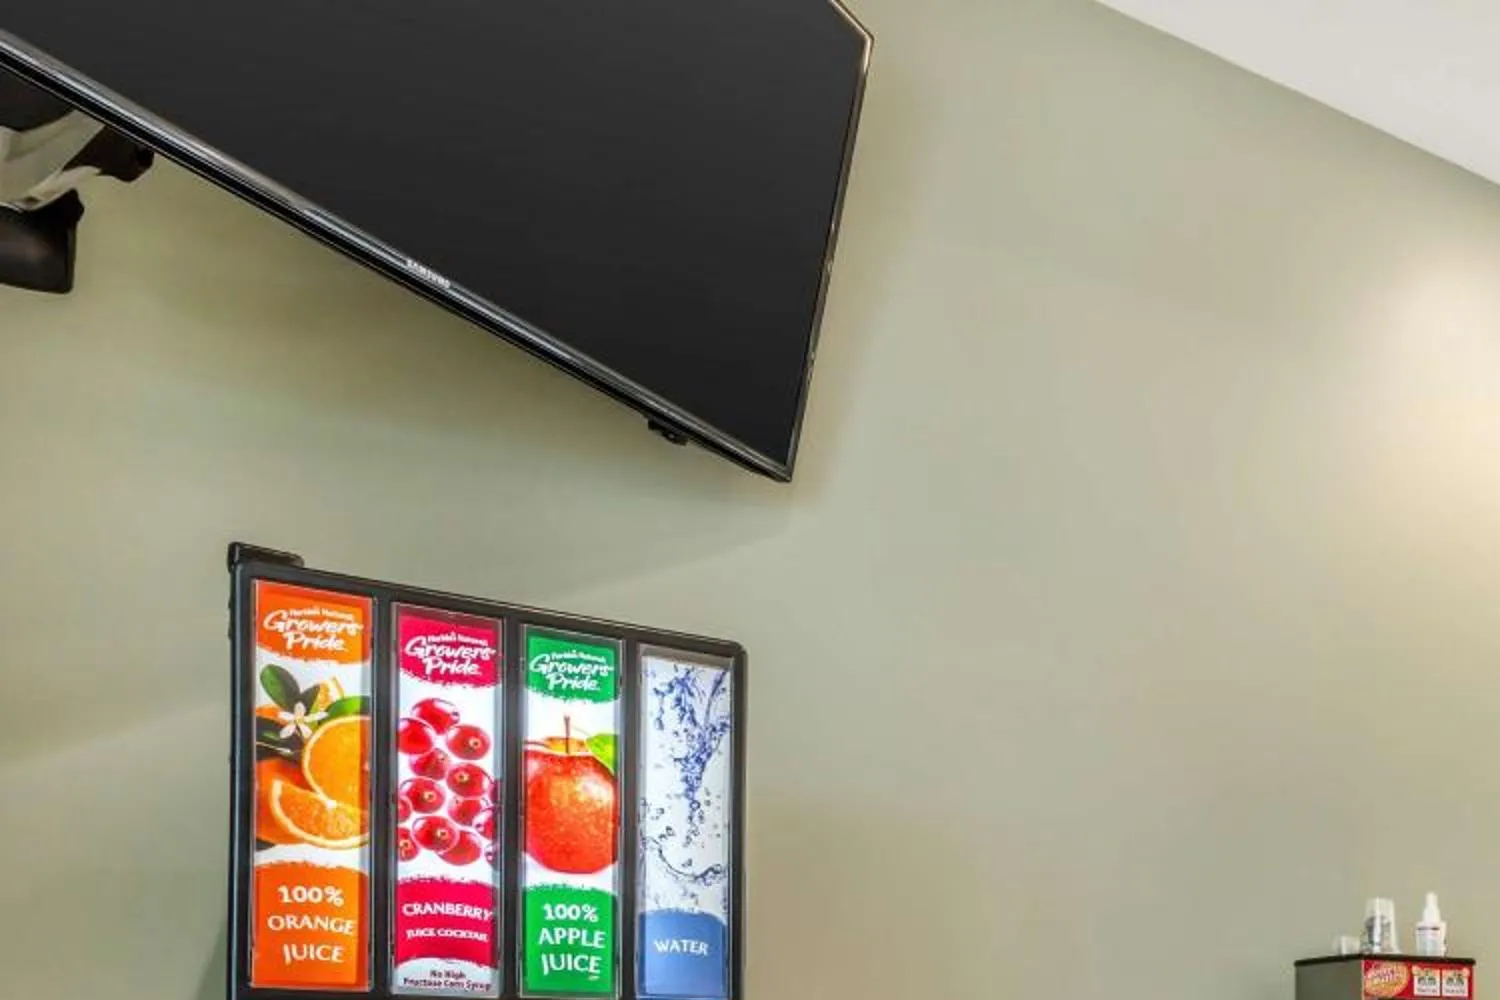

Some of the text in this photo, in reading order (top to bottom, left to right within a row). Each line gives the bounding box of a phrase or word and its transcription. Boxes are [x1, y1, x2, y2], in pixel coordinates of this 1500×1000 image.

[263, 609, 364, 636] Growers
[283, 632, 345, 651] Pride
[405, 635, 496, 660] Growers
[423, 657, 479, 676] Pride
[529, 653, 615, 677] Growers
[545, 671, 599, 691] Pride
[278, 885, 345, 907] 100%
[402, 902, 494, 921] CRANBERRY
[543, 903, 599, 923] 100%
[267, 915, 357, 936] ORANGE
[406, 928, 489, 942] JUICE COCKTAIL
[538, 927, 606, 949] APPLE
[653, 938, 709, 956] WATER
[283, 943, 345, 965] JUICE
[541, 953, 603, 976] JUICE
